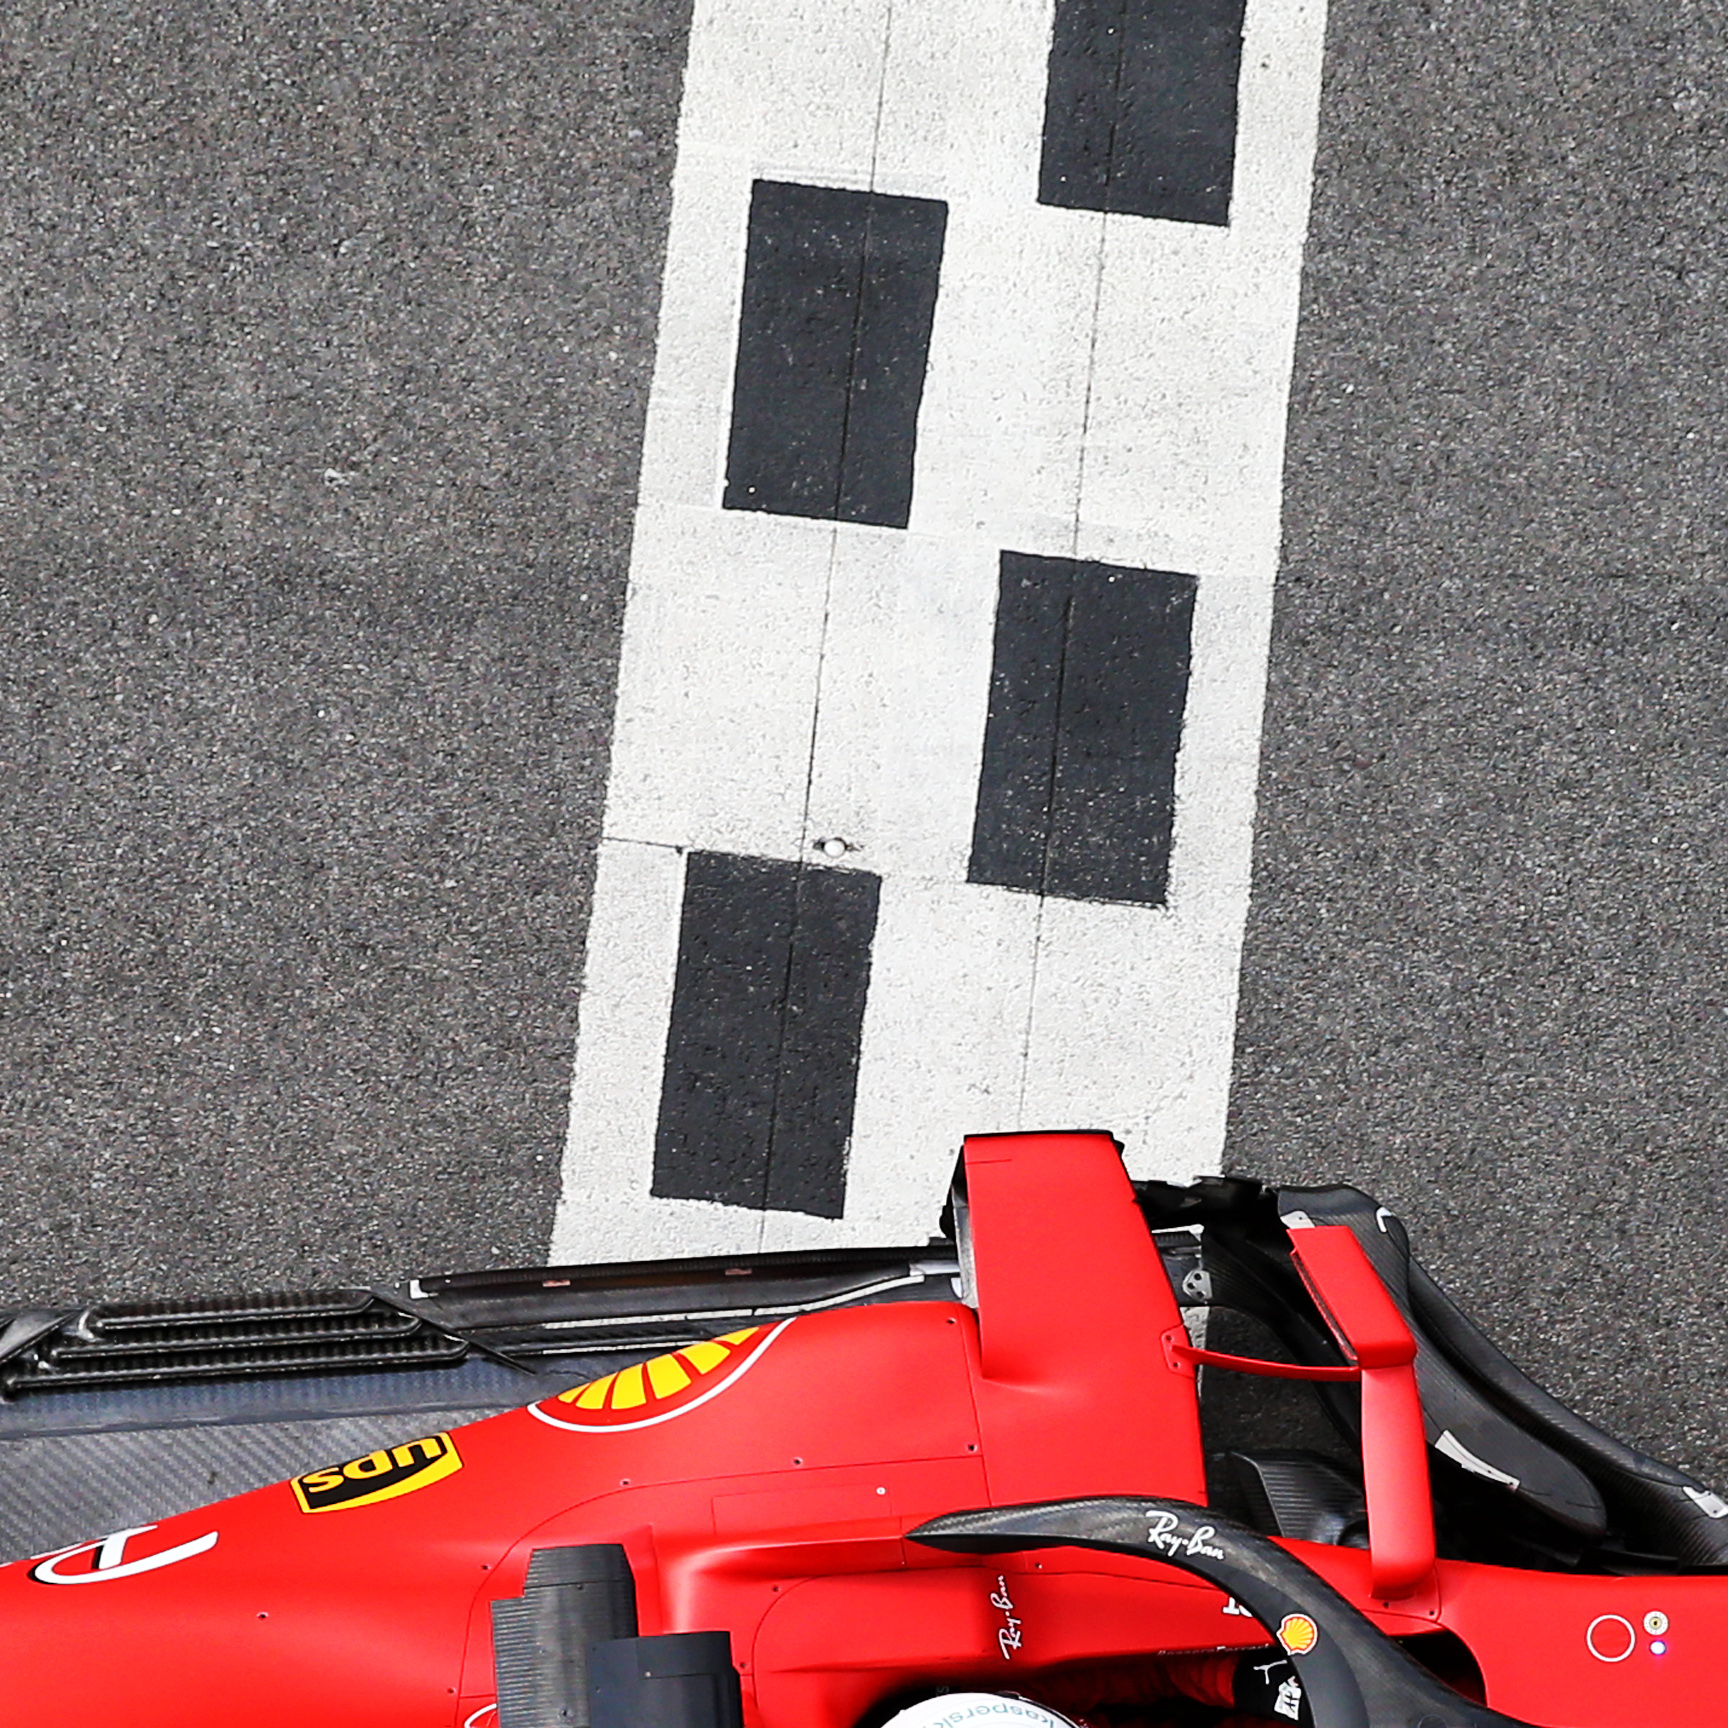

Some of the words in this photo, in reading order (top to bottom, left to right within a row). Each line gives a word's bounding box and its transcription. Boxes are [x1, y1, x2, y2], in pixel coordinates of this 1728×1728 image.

[302, 1437, 442, 1494] ups
[1145, 1509, 1225, 1561] Ray-Ban
[990, 1575, 1022, 1660] Ray-Ban
